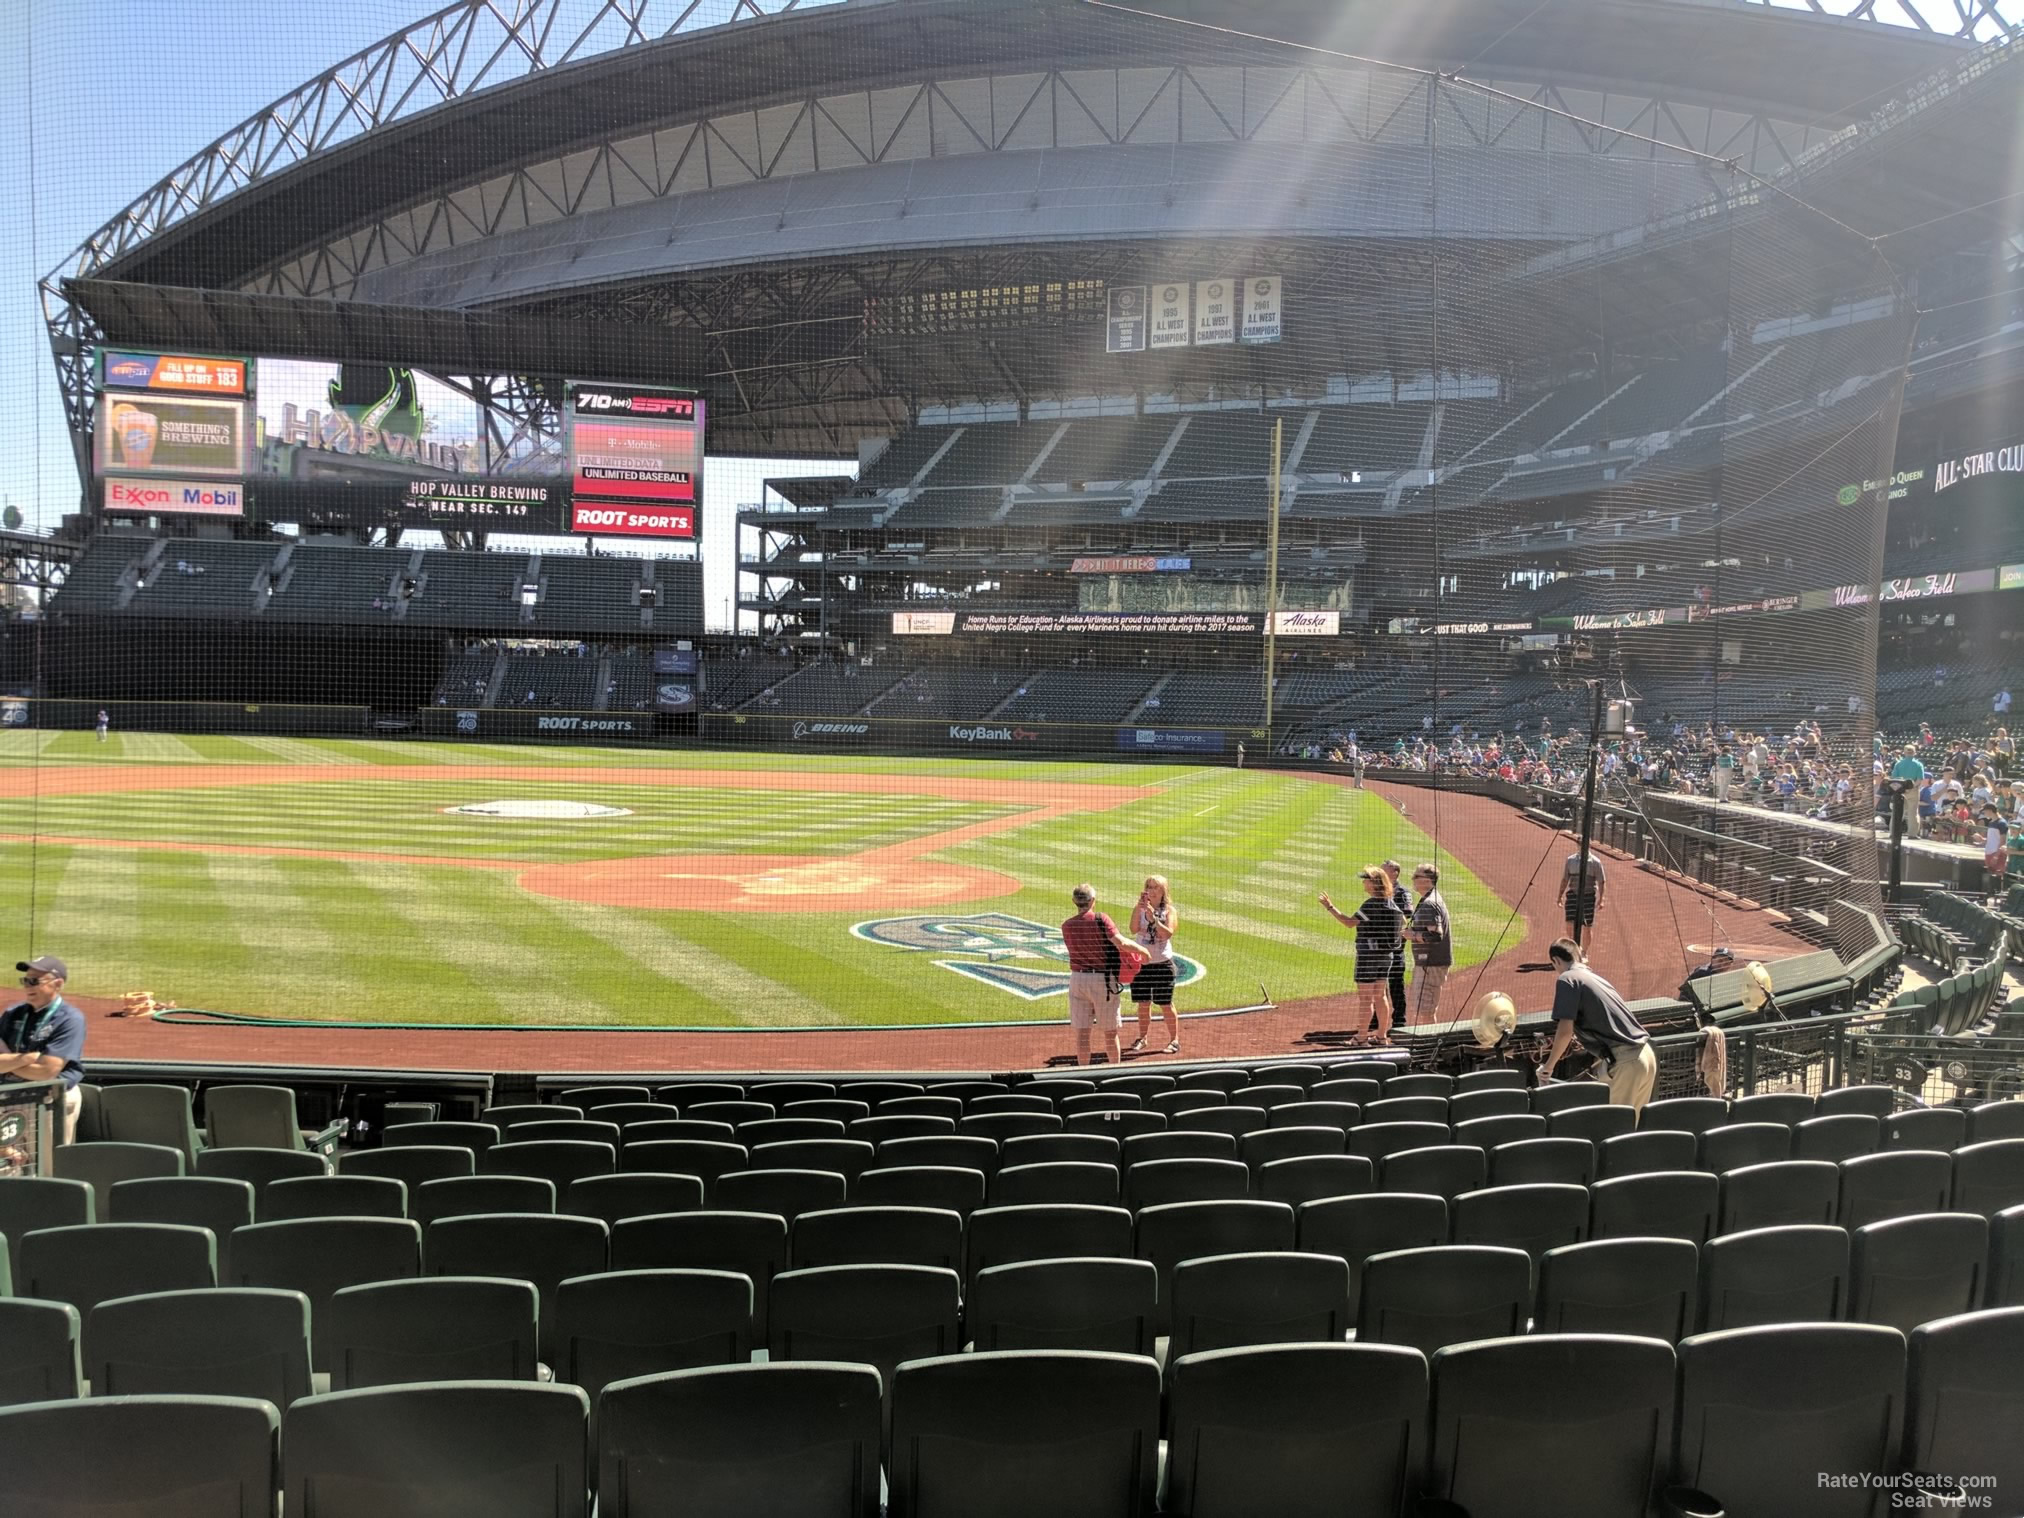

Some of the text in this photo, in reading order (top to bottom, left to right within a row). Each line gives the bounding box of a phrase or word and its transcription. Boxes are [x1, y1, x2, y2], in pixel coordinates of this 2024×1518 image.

[1212, 316, 1229, 326] WEST
[1259, 313, 1276, 323] WEST
[1168, 320, 1184, 330] WEST
[1244, 325, 1279, 337] CHAMPIONS
[1153, 332, 1187, 344] CHAMPIONS
[1197, 329, 1233, 341] CHAMPIONS
[216, 372, 238, 387] 183
[577, 393, 612, 409] 710
[631, 396, 693, 414] ESPN
[161, 421, 230, 435] SOMETHING'S
[161, 432, 231, 445] BREWING
[580, 457, 660, 470] UNLIMITED DATA
[585, 468, 688, 483] UNLIMITED BASEBALL
[112, 484, 236, 506] Exxon Mobil
[411, 481, 547, 501] HOP VALLEY BREWING
[431, 501, 527, 516] NEAR SEC. 149
[576, 509, 688, 529] ROOT SPORTS
[1096, 559, 1109, 570] HIT
[1122, 559, 1143, 570] HERE
[2003, 571, 2022, 582] JOIN
[1886, 579, 1921, 600] Safeco
[1922, 572, 1957, 596] Field
[968, 615, 988, 623] Home
[989, 615, 1007, 623] Runs
[1008, 615, 1018, 623] for
[1019, 615, 1053, 623] Education
[1059, 615, 1084, 623] Alaska
[1084, 615, 1112, 623] Airlines
[1113, 615, 1119, 623] is
[1120, 615, 1143, 625] proud
[1144, 615, 1151, 623] to
[1152, 615, 1177, 623] donate
[1178, 615, 1203, 623] airline
[1204, 615, 1225, 623] miles
[1226, 615, 1235, 623] to
[1236, 615, 1249, 623] the
[1283, 613, 1326, 627] Alaska
[1572, 614, 1611, 630] Welcome
[1613, 618, 1622, 629] to
[962, 623, 984, 631] United
[985, 623, 1007, 633] Negro
[1007, 623, 1034, 633] College
[1034, 623, 1053, 631] Fund
[1054, 623, 1064, 631] for
[1067, 624, 1087, 633] every
[1168, 624, 1193, 633] during
[1207, 623, 1227, 632] 2017
[1227, 624, 1255, 632] season
[1451, 624, 1467, 634] THAT
[1468, 622, 1489, 633] GOOD
[538, 717, 632, 731] ROOT SPORTS
[811, 723, 869, 734] BOEING
[949, 726, 1012, 742] KeyBank
[1166, 733, 1202, 742] Insurance
[1895, 1067, 1912, 1081] 33
[2, 1123, 17, 1140] 33
